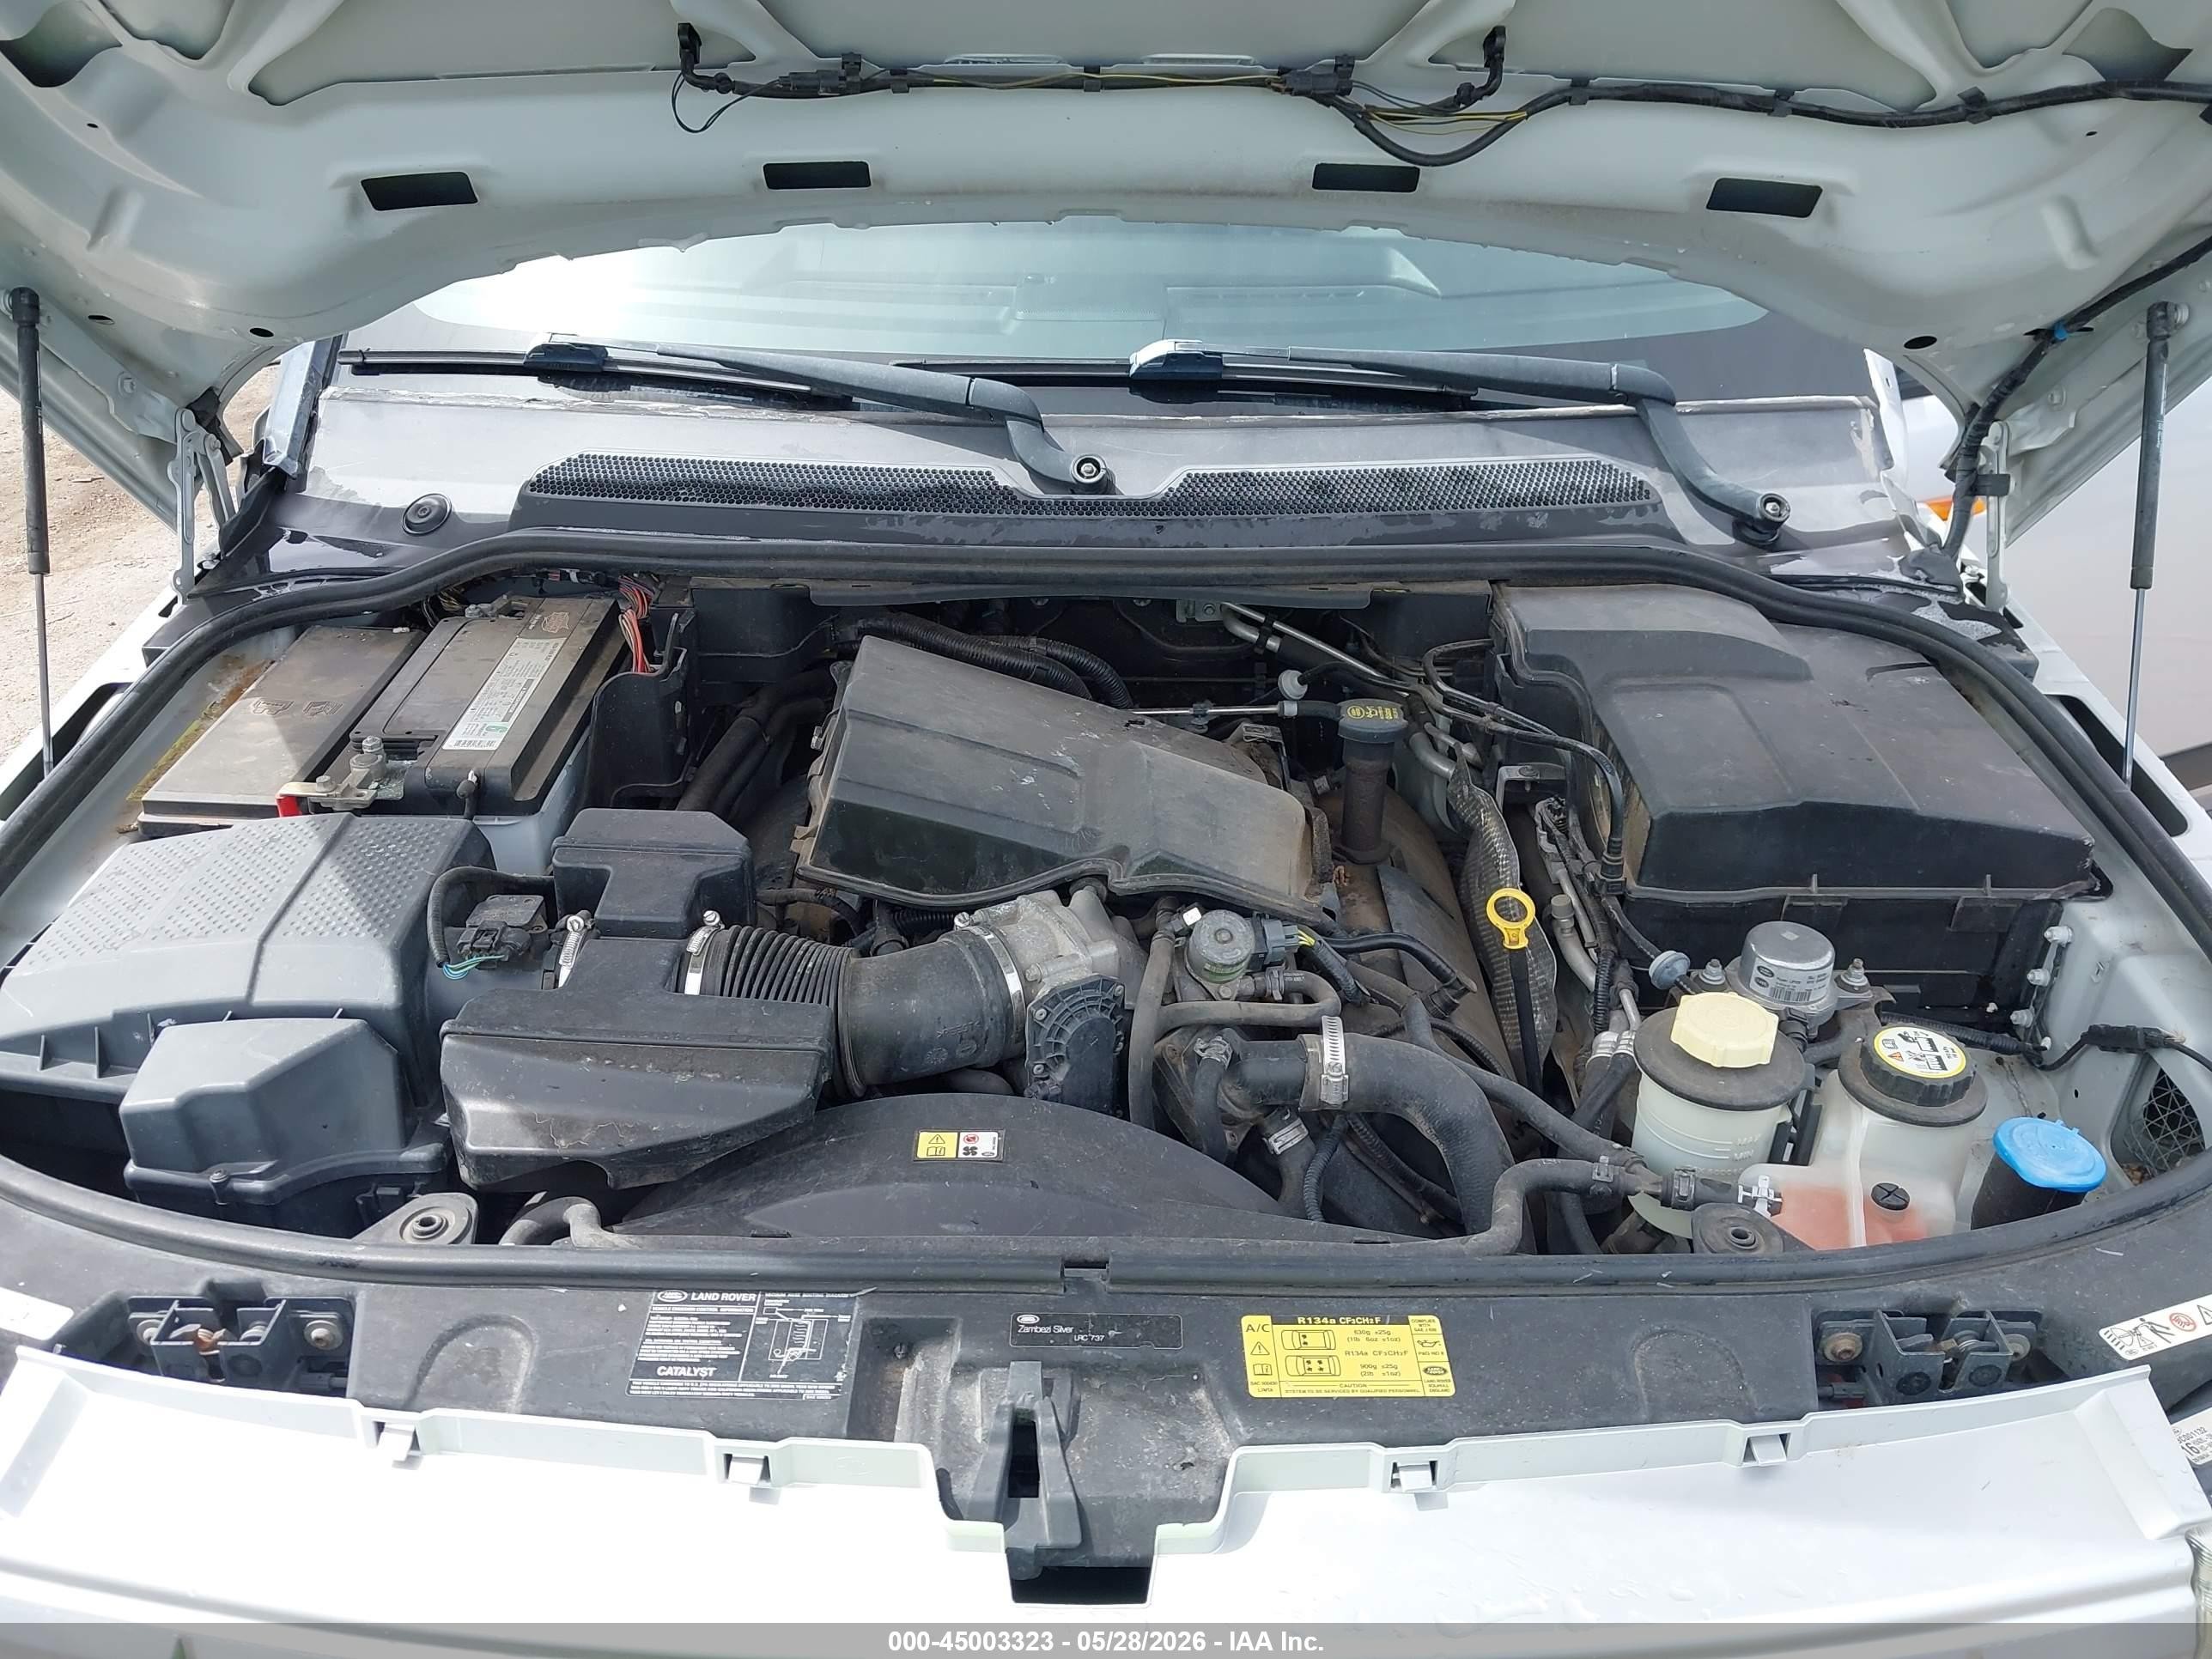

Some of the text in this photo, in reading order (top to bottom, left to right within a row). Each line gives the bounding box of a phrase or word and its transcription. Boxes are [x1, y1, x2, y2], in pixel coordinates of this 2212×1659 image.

[690, 1291, 757, 1302] LAND ROVER
[1018, 1325, 1051, 1334] Zambezi
[657, 1366, 717, 1377] CATALYST
[2181, 1443, 2200, 1456] 16
